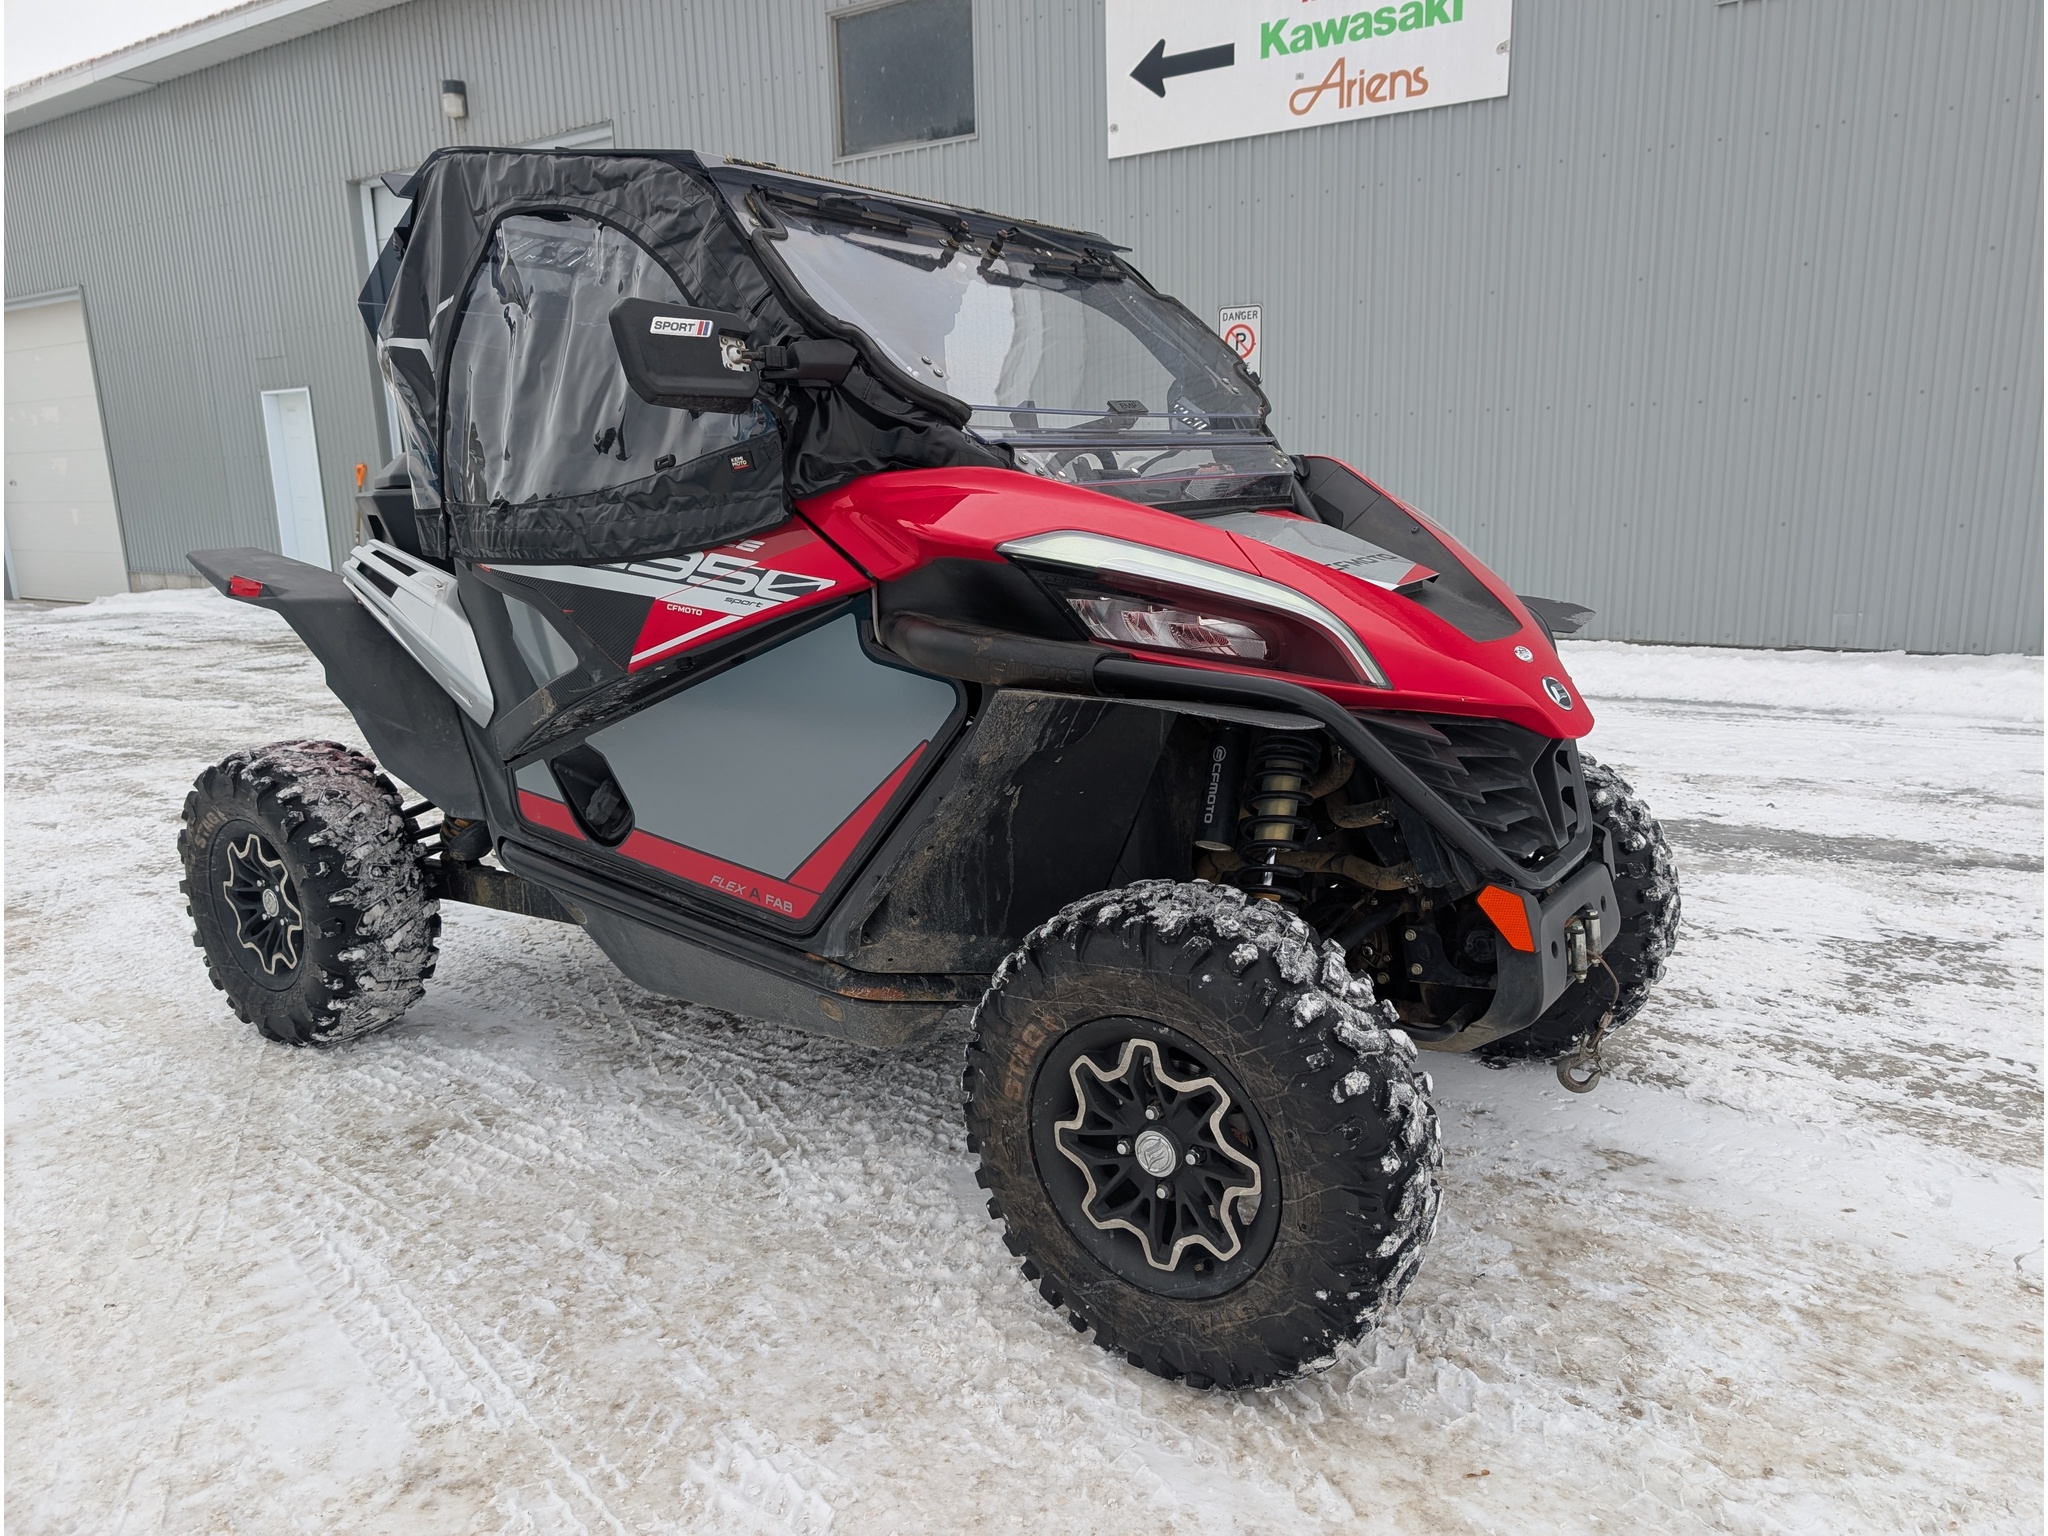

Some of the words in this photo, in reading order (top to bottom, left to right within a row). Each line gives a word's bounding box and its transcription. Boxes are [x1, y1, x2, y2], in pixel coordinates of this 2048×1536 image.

[1260, 0, 1463, 59] Kawasaki
[1289, 57, 1428, 115] Ariens
[653, 320, 696, 333] SPORT
[1222, 310, 1258, 321] DANGER
[666, 603, 703, 616] CFMOTO
[723, 596, 764, 609] sport
[1203, 763, 1222, 824] CFMOTO
[710, 875, 747, 896] FLEX
[748, 887, 761, 902] A
[765, 893, 793, 914] FAB
